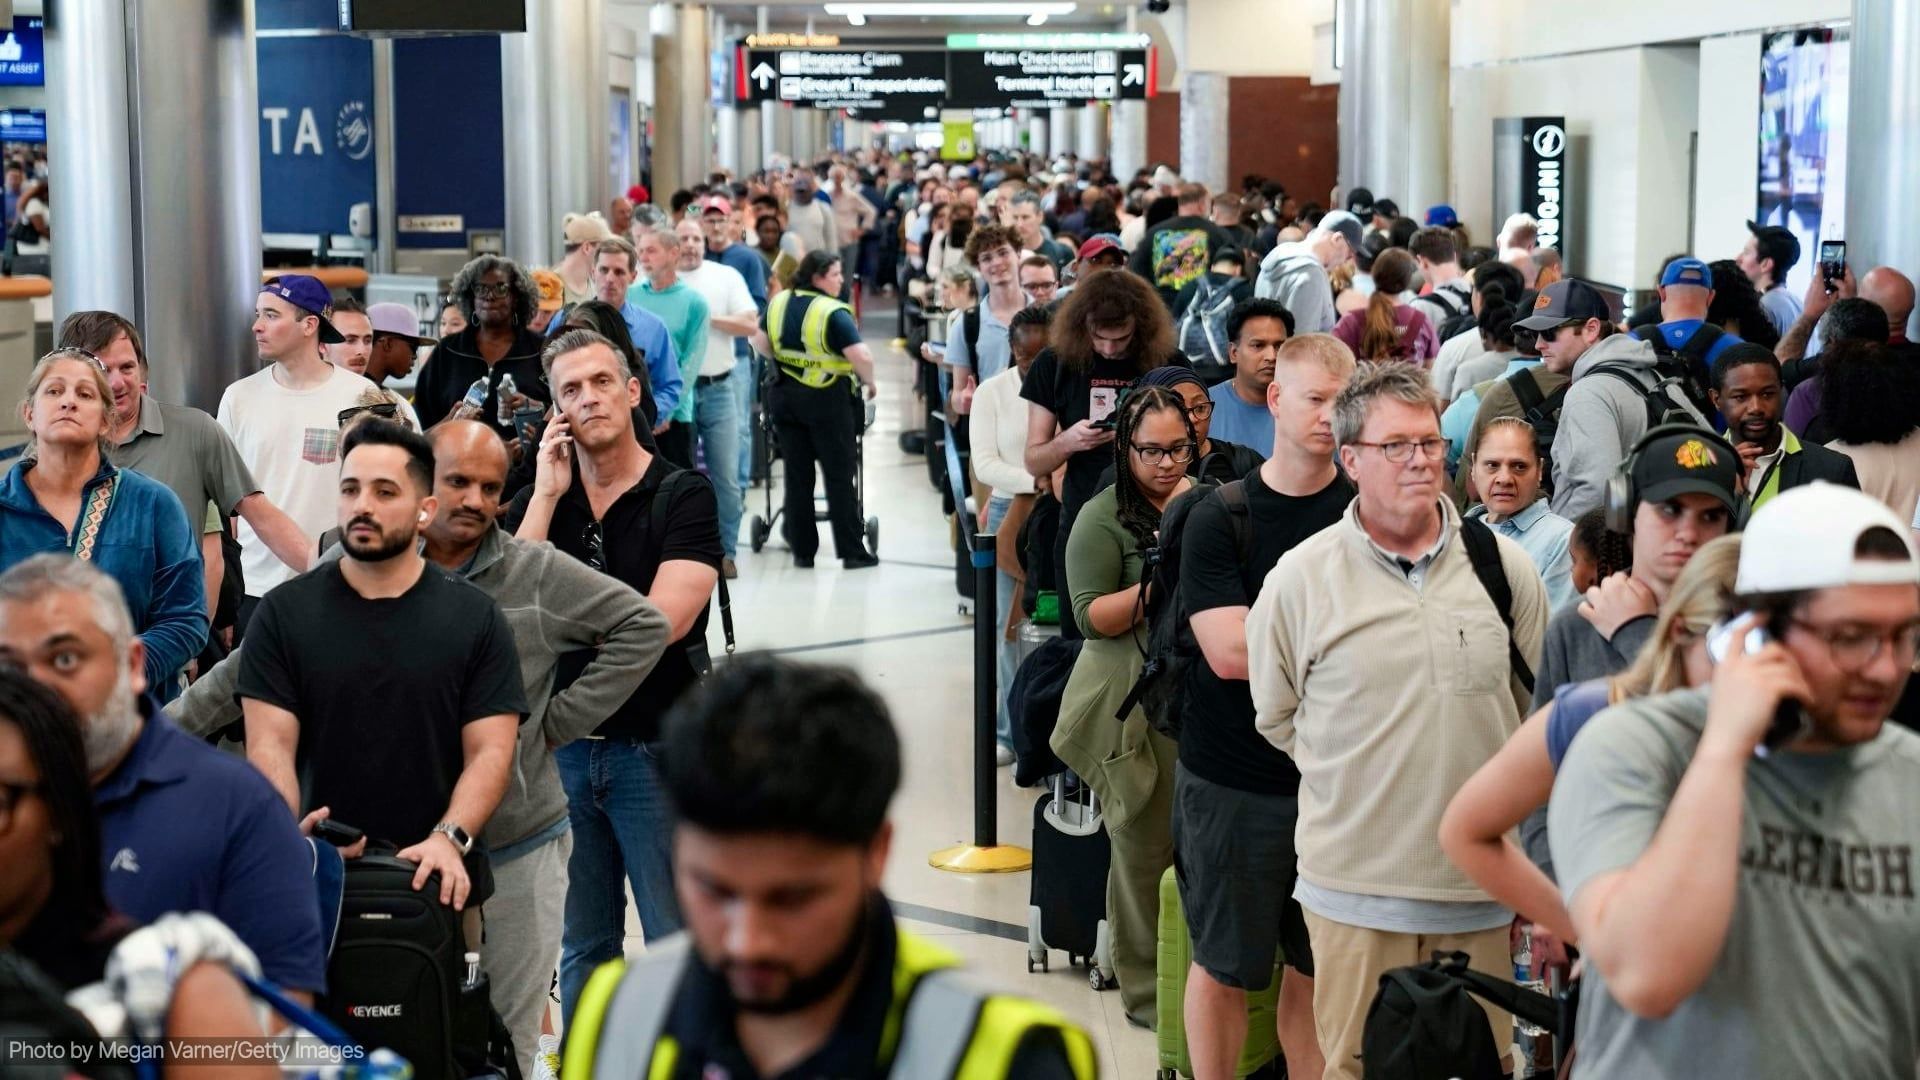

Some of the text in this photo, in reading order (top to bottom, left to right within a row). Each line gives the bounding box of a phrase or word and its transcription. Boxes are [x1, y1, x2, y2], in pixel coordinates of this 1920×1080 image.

[863, 51, 903, 67] Claim
[984, 50, 1094, 68] Main Checkpoint
[9, 62, 40, 74] ASSIST
[995, 76, 1094, 91] Terminal North
[1091, 379, 1133, 387] gastro
[346, 1004, 402, 1018] KEYENCE
